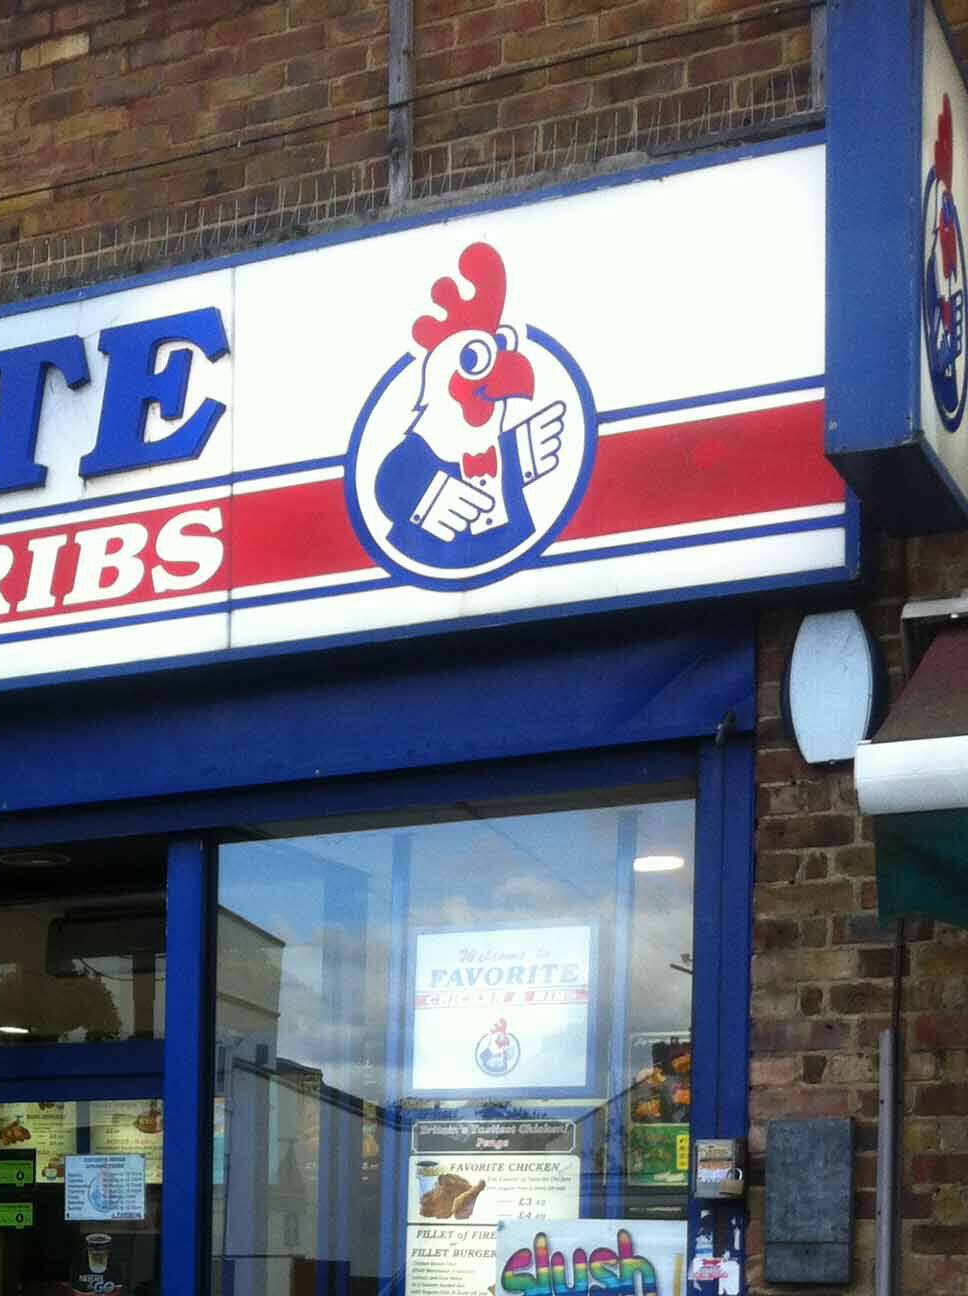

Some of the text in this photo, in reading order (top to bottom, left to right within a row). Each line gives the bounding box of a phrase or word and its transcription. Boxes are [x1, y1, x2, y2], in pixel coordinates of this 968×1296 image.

[430, 963, 579, 987] FAVORITE
[449, 1161, 561, 1172] FAVORITE CHICKEN
[416, 1229, 455, 1240] FILLET
[457, 1230, 468, 1241] of
[410, 1248, 449, 1258] FILLET
